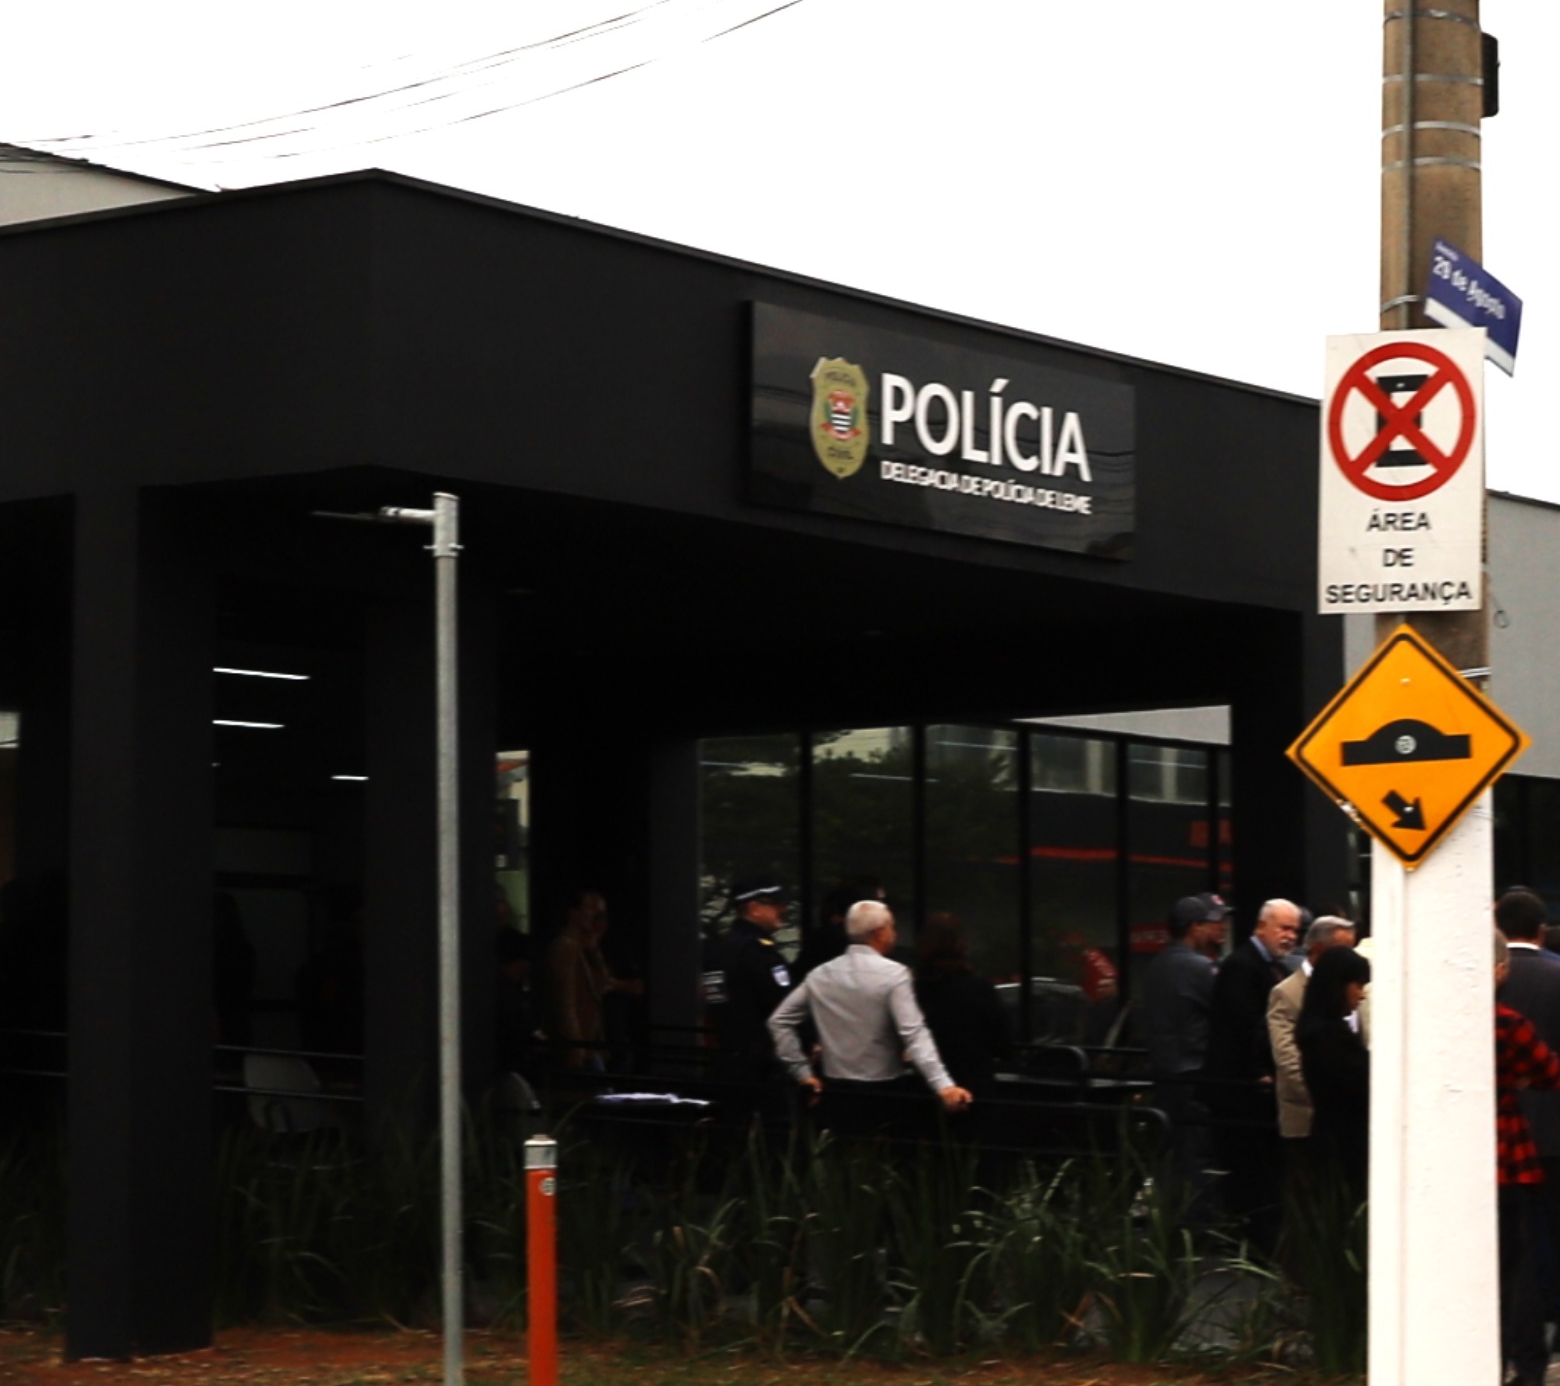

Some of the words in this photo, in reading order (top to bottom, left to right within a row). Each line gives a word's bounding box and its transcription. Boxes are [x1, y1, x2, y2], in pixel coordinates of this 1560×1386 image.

[881, 373, 1092, 481] POLÍCIA
[880, 460, 959, 490] DELEGACIA
[1366, 508, 1431, 532] ÁREA
[1383, 548, 1414, 567] DE
[1326, 581, 1473, 605] SEGURANÇA
